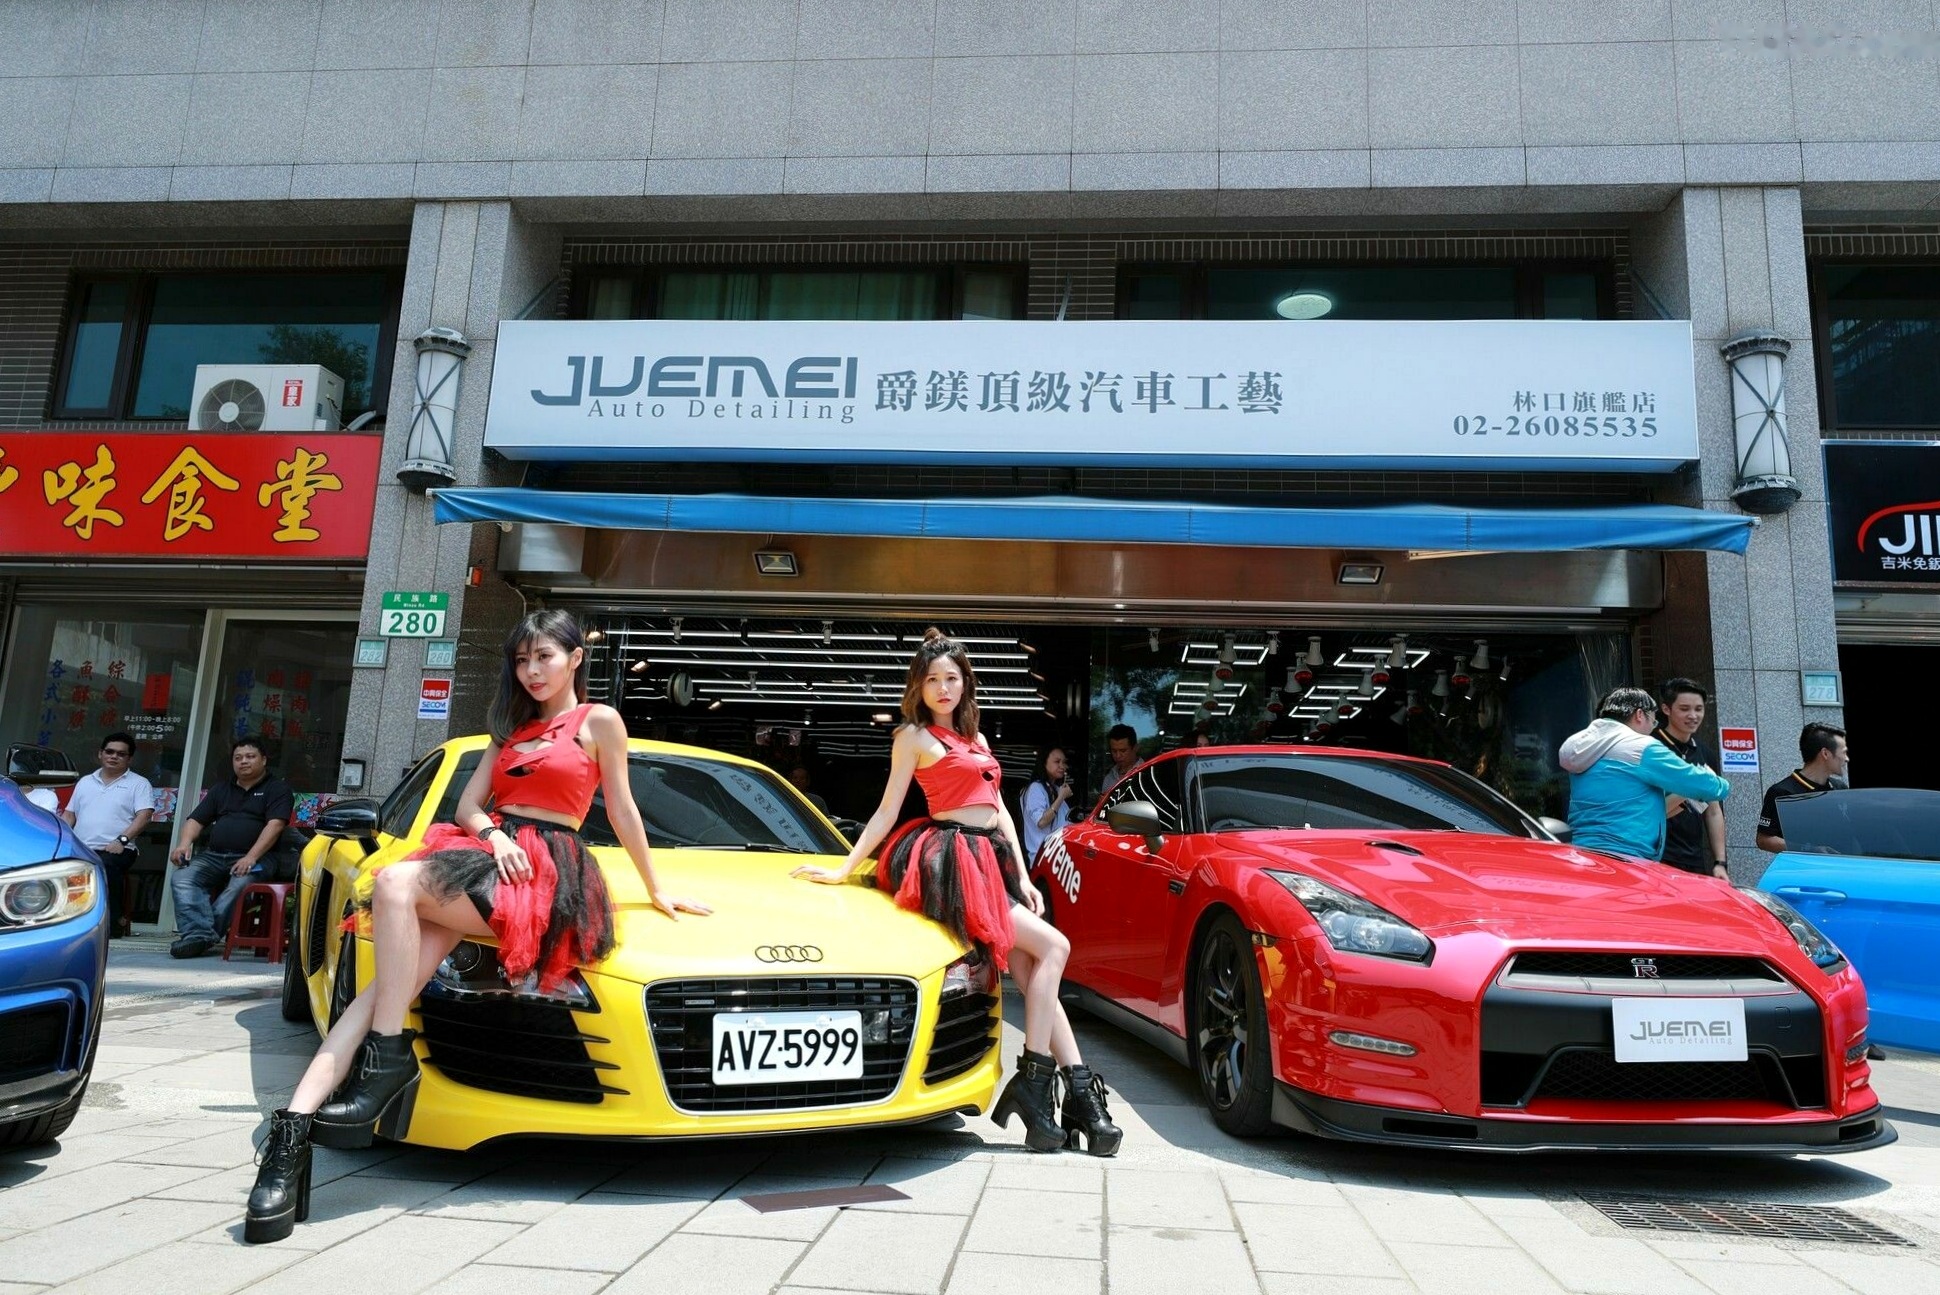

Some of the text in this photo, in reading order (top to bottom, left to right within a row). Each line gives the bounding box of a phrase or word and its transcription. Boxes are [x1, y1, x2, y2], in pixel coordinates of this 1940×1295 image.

[530, 356, 858, 406] JUEMEI
[874, 370, 1284, 415] 爵鎂頂級汽車工藝
[1512, 390, 1656, 413] 林口旗艦店
[588, 399, 855, 424] Auto Detailing
[1453, 415, 1657, 437] 02-26085535
[0, 444, 343, 542] 味食堂
[1878, 514, 1940, 556] JI
[393, 594, 438, 604] 民族路
[388, 612, 437, 634] 280
[429, 652, 451, 663] 280
[1808, 687, 1834, 699] 278
[1725, 752, 1755, 760] SECOM
[1630, 1021, 1732, 1040] JUEMEI
[1649, 1036, 1733, 1046] Auto Detailing
